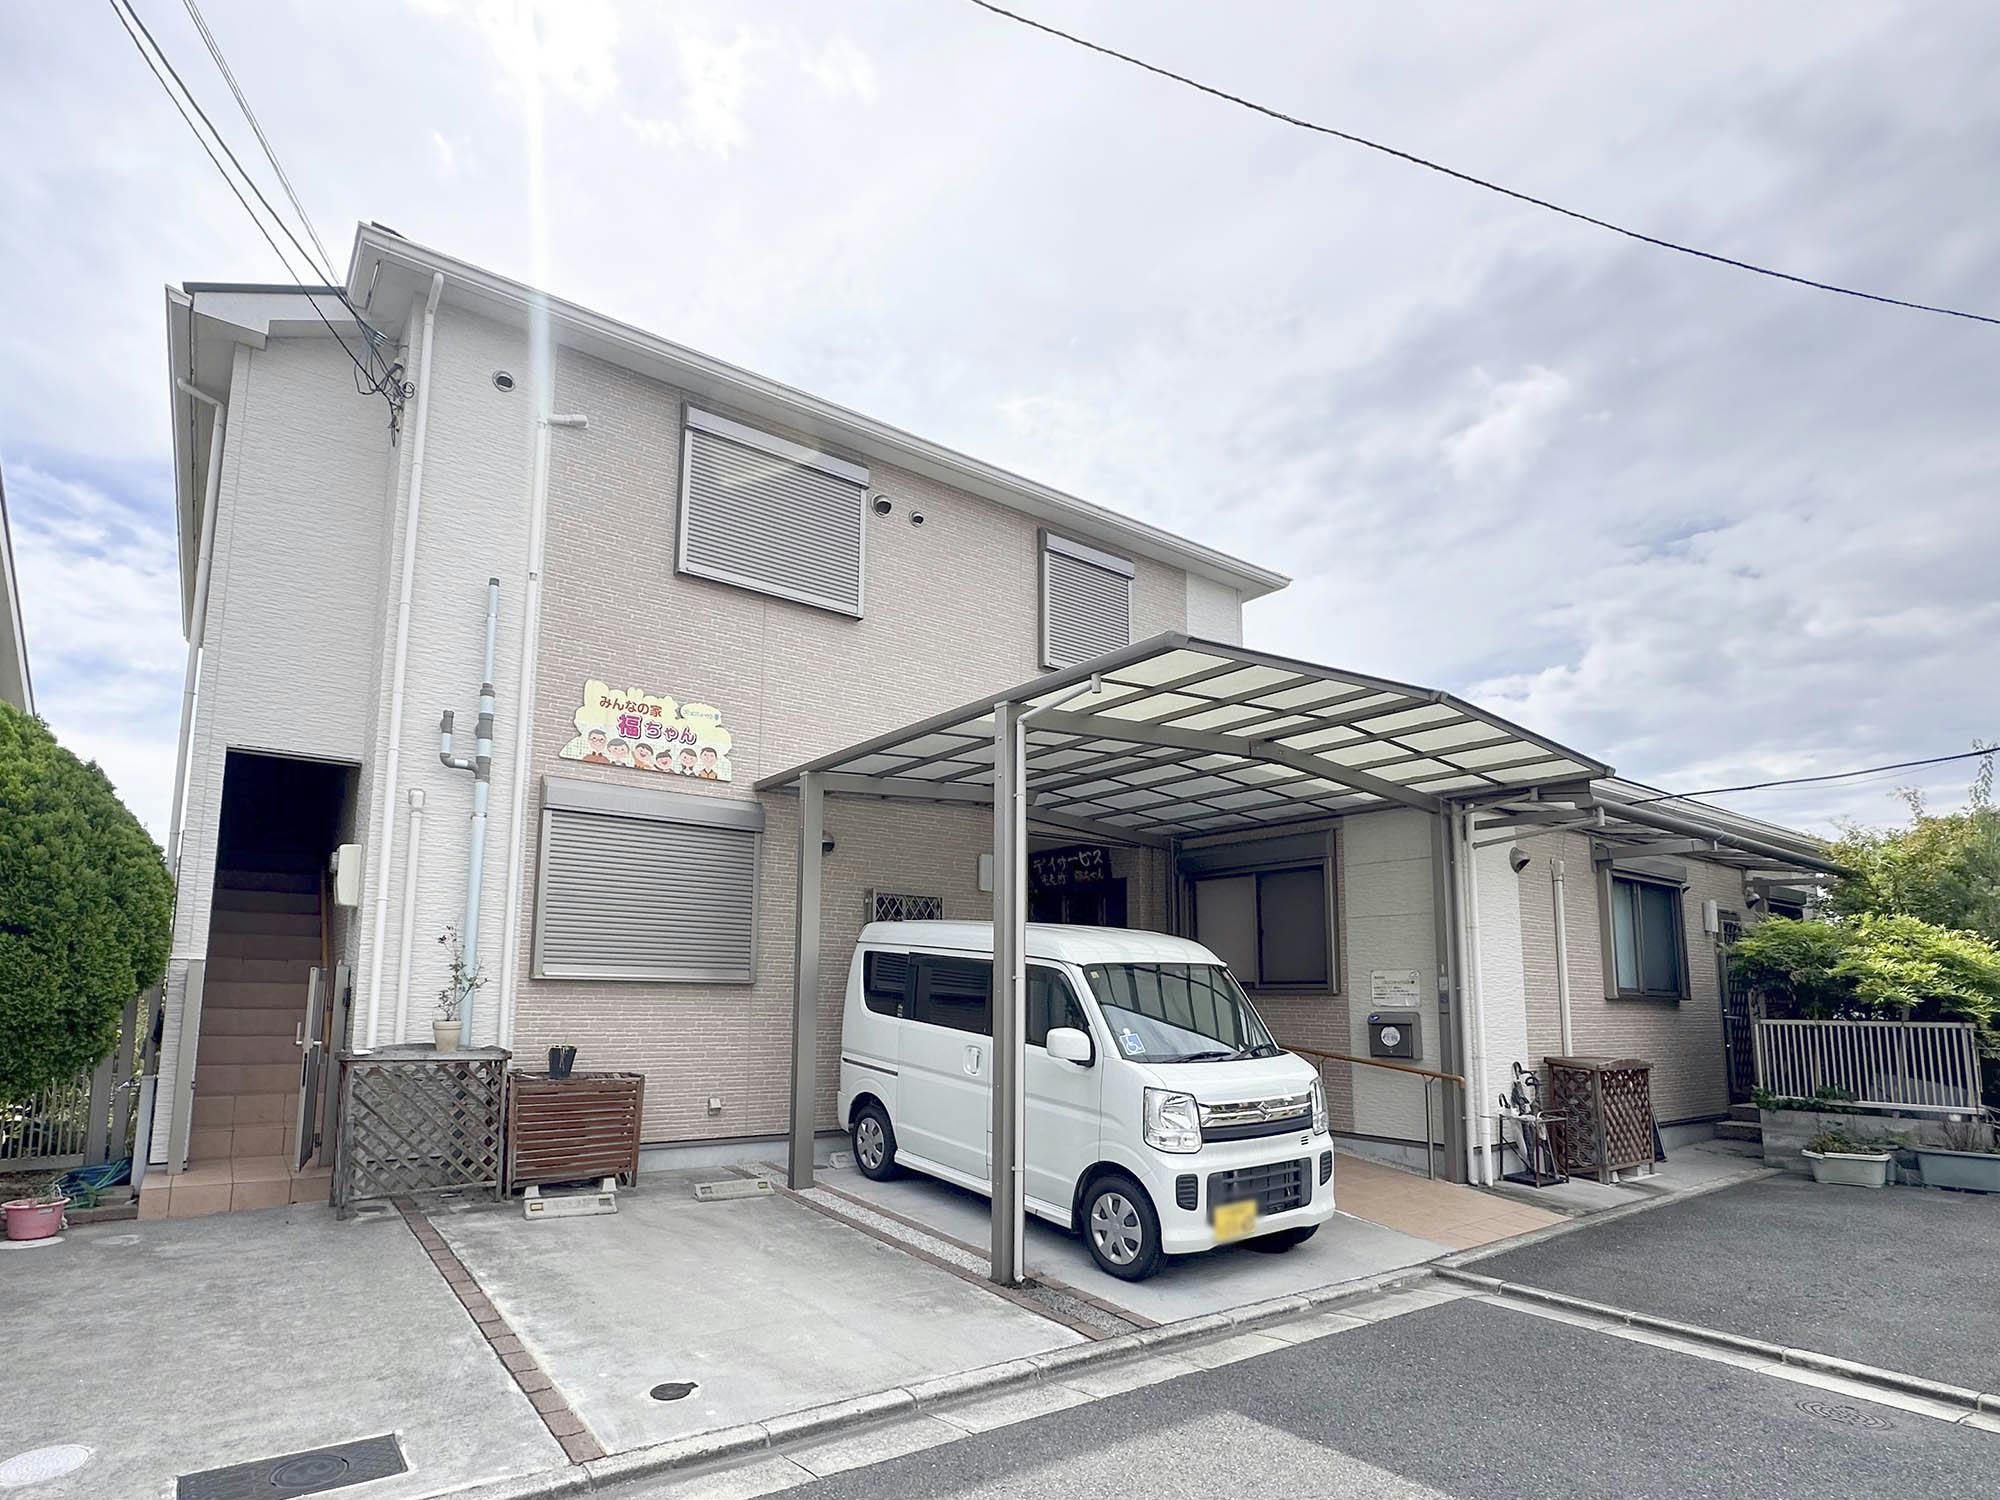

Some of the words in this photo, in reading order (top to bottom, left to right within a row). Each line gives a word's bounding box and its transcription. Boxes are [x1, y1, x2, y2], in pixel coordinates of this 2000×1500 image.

[599, 696, 662, 718] みんなの家
[617, 714, 697, 745] 福ちゃん
[1033, 849, 1103, 874] デイサービス
